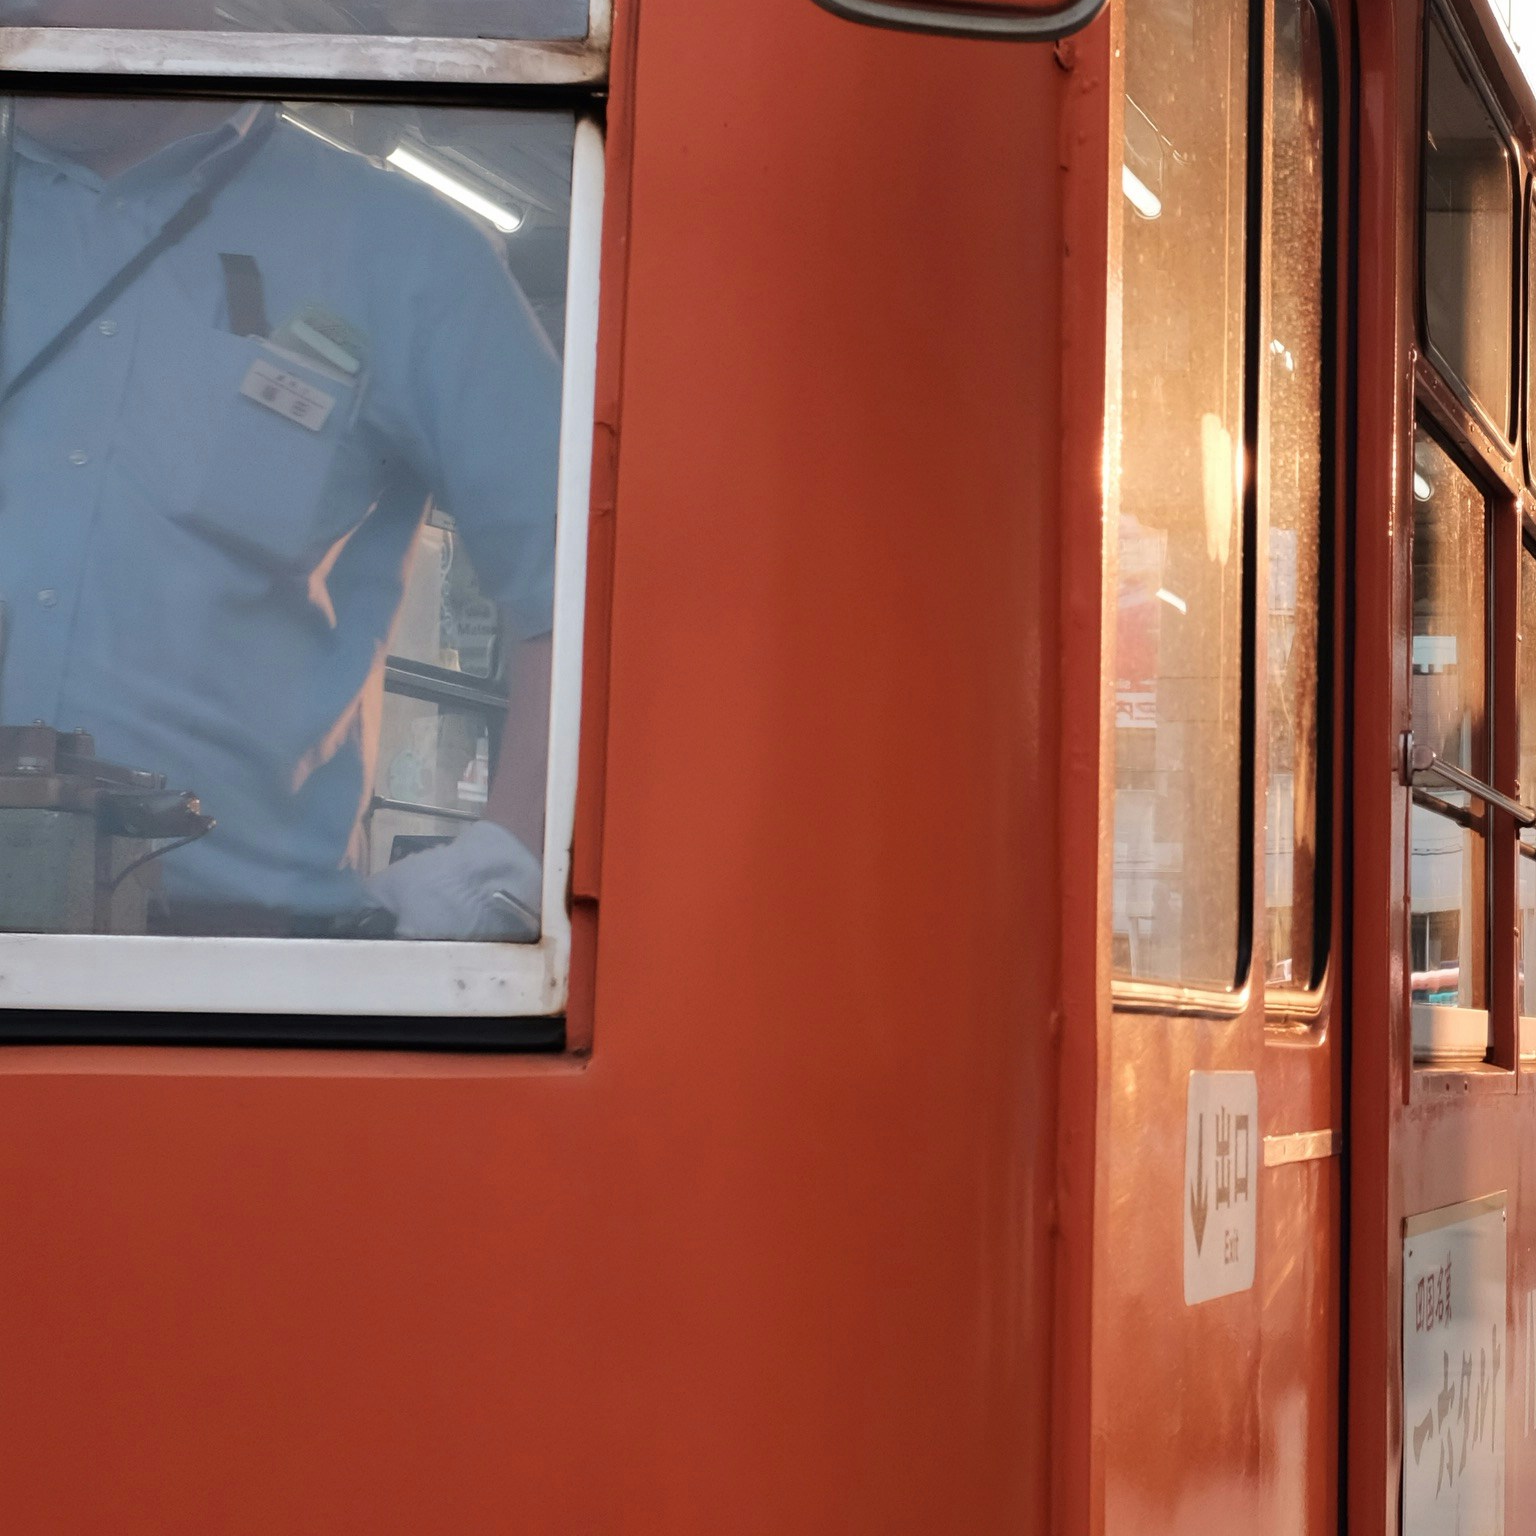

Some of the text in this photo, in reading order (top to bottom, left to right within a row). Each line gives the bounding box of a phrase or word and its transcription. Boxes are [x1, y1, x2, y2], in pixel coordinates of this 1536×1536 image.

[1216, 1106, 1248, 1210] 出口
[1224, 1229, 1239, 1264] Exit
[1413, 1323, 1500, 1500] 一六タルト
